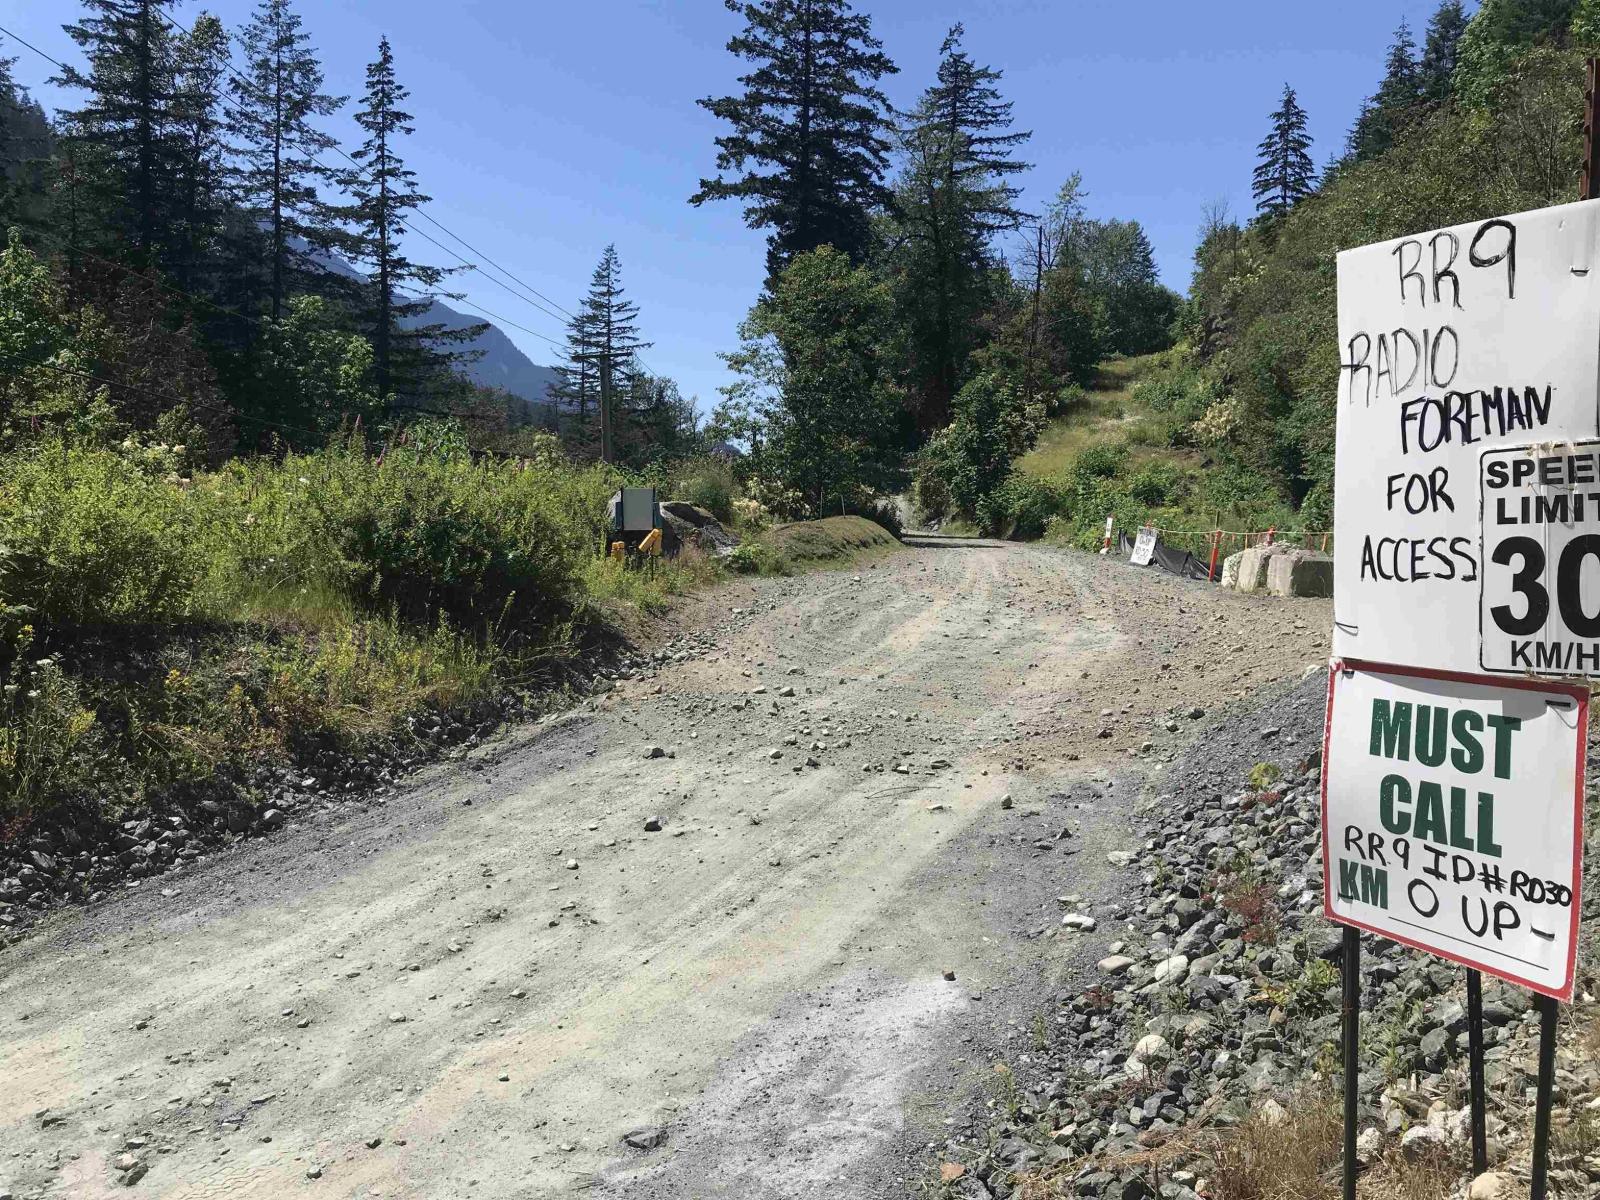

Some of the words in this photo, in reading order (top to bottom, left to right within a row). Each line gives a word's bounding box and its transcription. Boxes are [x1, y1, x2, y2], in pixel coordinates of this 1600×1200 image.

[1342, 326, 1459, 408] RADIO
[1401, 385, 1552, 454] FOREMAN
[1387, 466, 1455, 514] FOR
[1486, 454, 1600, 489] SPEE
[1361, 535, 1477, 583] ACCESS
[1491, 534, 1600, 638] 30
[1511, 640, 1600, 671] KM/H
[1369, 698, 1522, 780] MUST
[1379, 774, 1502, 858] CALL
[1339, 858, 1389, 910] KM
[1461, 895, 1521, 941] UP
